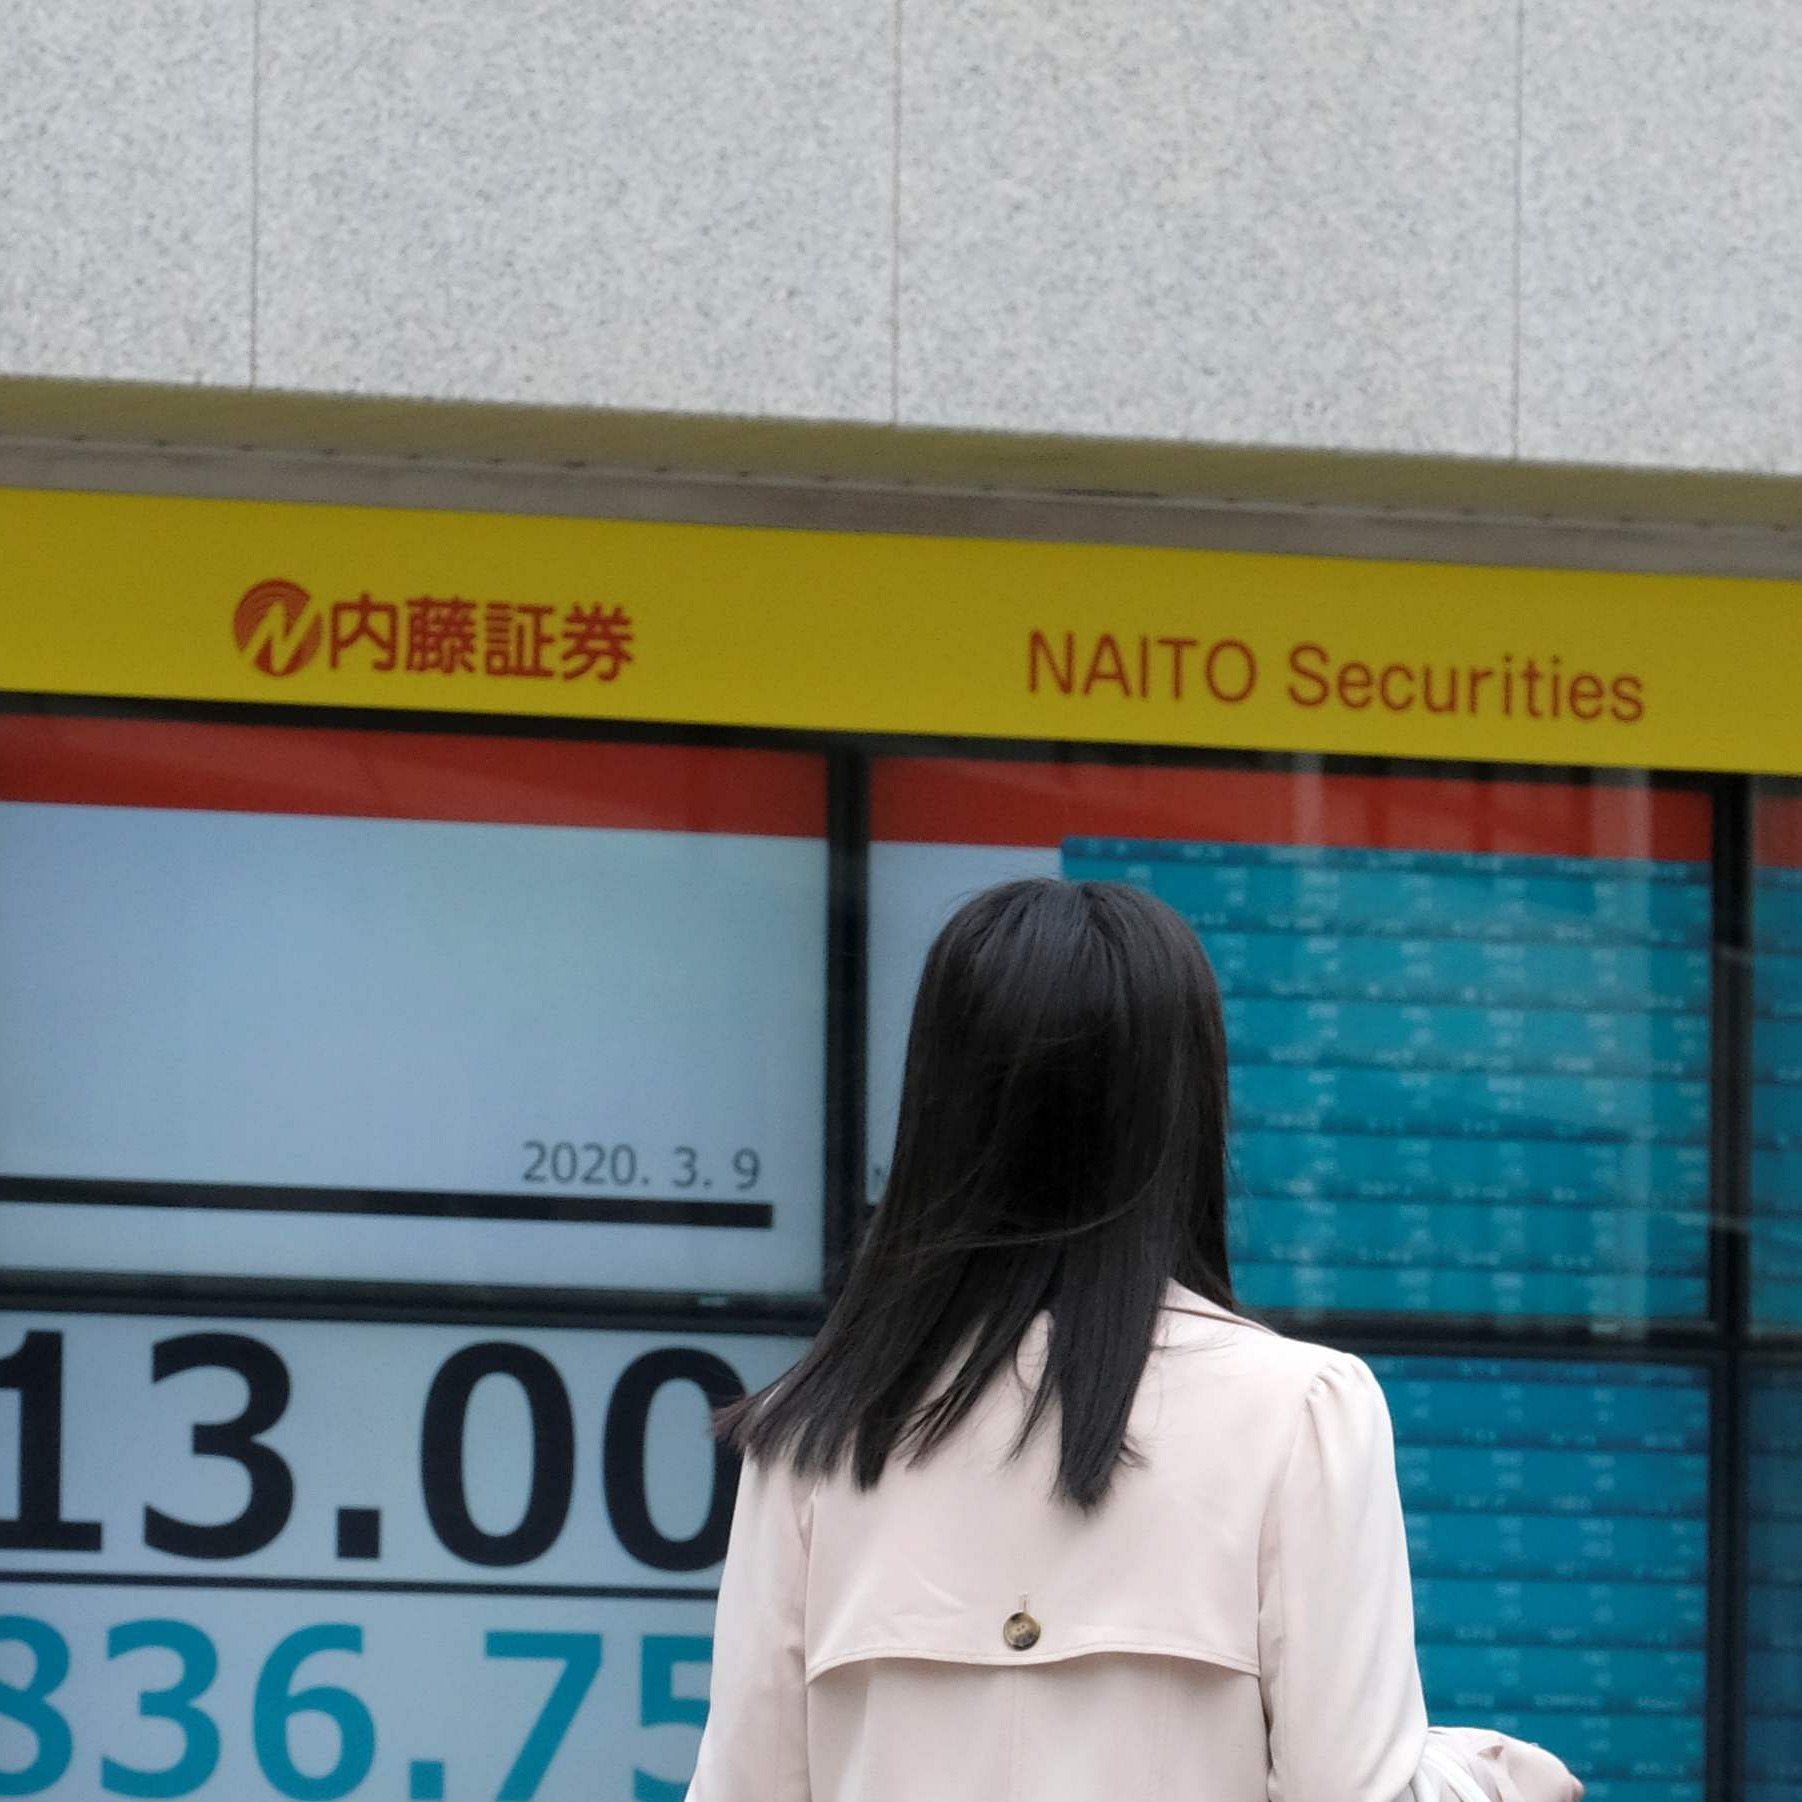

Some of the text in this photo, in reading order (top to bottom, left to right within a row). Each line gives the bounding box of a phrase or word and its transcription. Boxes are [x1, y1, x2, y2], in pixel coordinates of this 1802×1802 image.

[329, 592, 635, 683] 内藤証券
[1026, 629, 1646, 724] NAITO Securities
